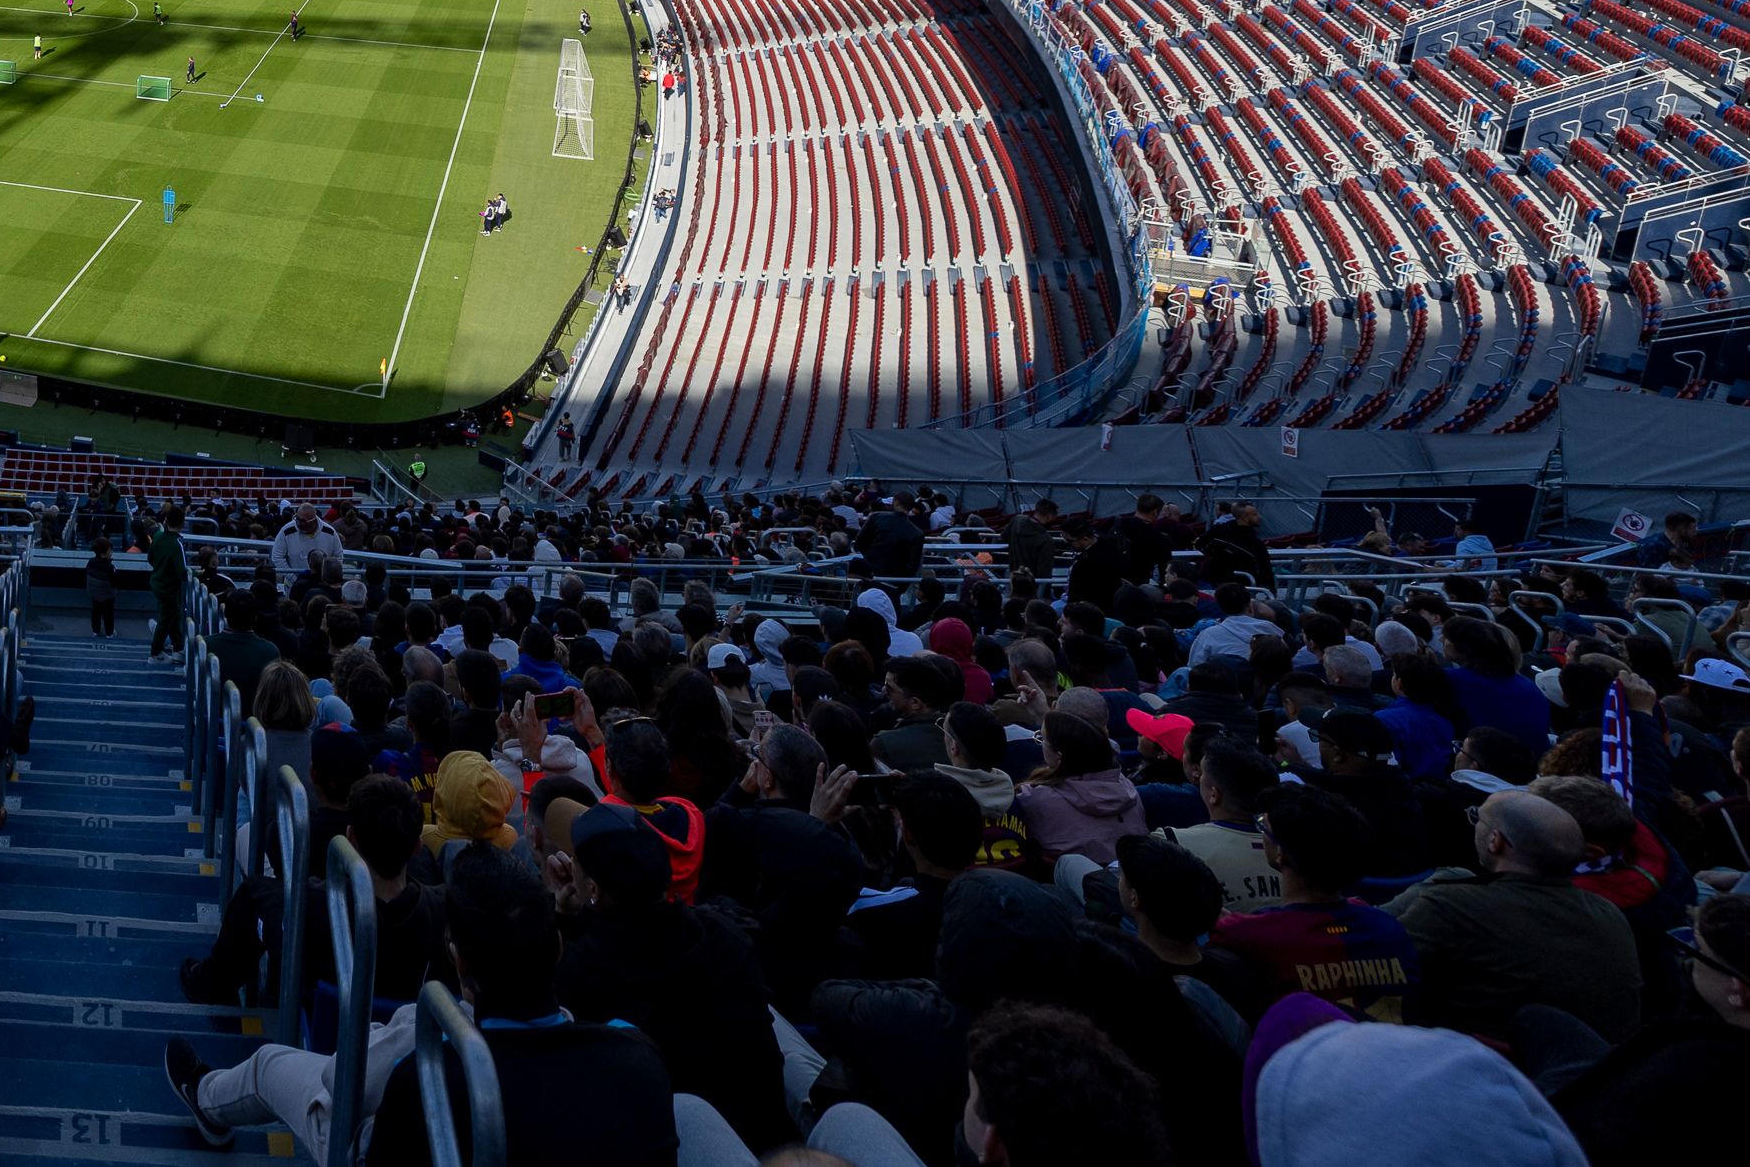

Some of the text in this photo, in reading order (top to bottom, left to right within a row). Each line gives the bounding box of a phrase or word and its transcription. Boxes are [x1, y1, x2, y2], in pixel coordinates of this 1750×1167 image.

[88, 775, 110, 786] 08
[85, 816, 110, 828] 09
[84, 855, 108, 869] 10
[85, 920, 110, 937] 11
[1295, 957, 1407, 991] RAPHINHA
[81, 1002, 114, 1026] 12
[71, 1114, 111, 1145] 13
